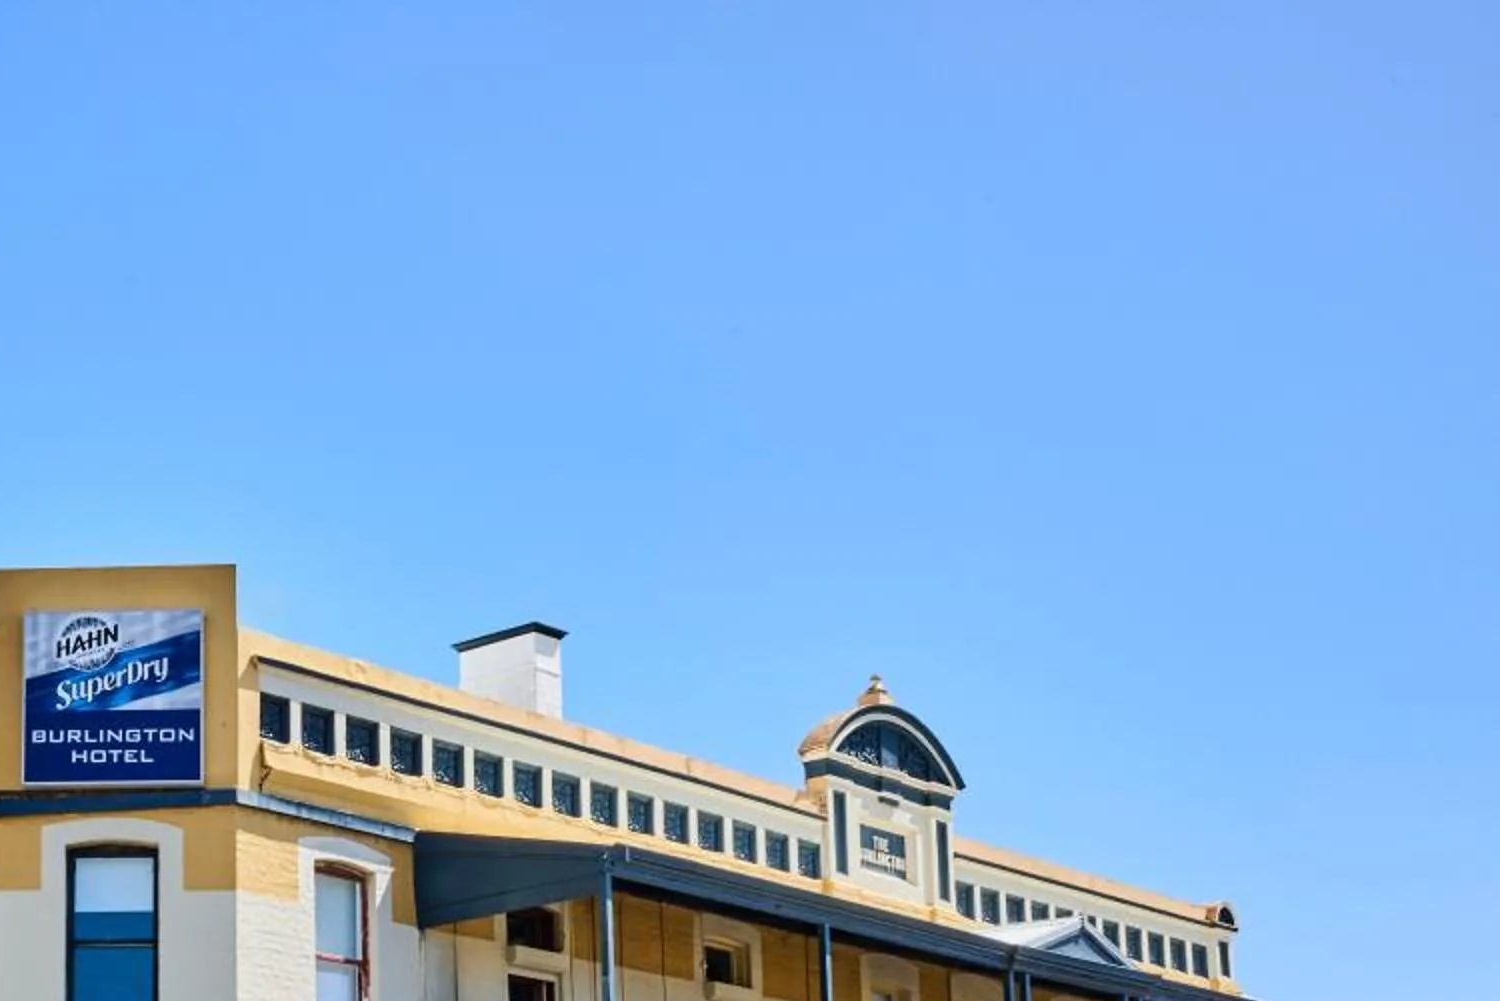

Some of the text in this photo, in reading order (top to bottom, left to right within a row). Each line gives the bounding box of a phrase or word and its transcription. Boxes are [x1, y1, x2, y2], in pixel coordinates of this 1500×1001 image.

[56, 623, 119, 658] HAHN
[55, 656, 170, 711] SuperDry
[31, 727, 195, 744] BURLINGTON
[71, 748, 155, 764] HOTEL
